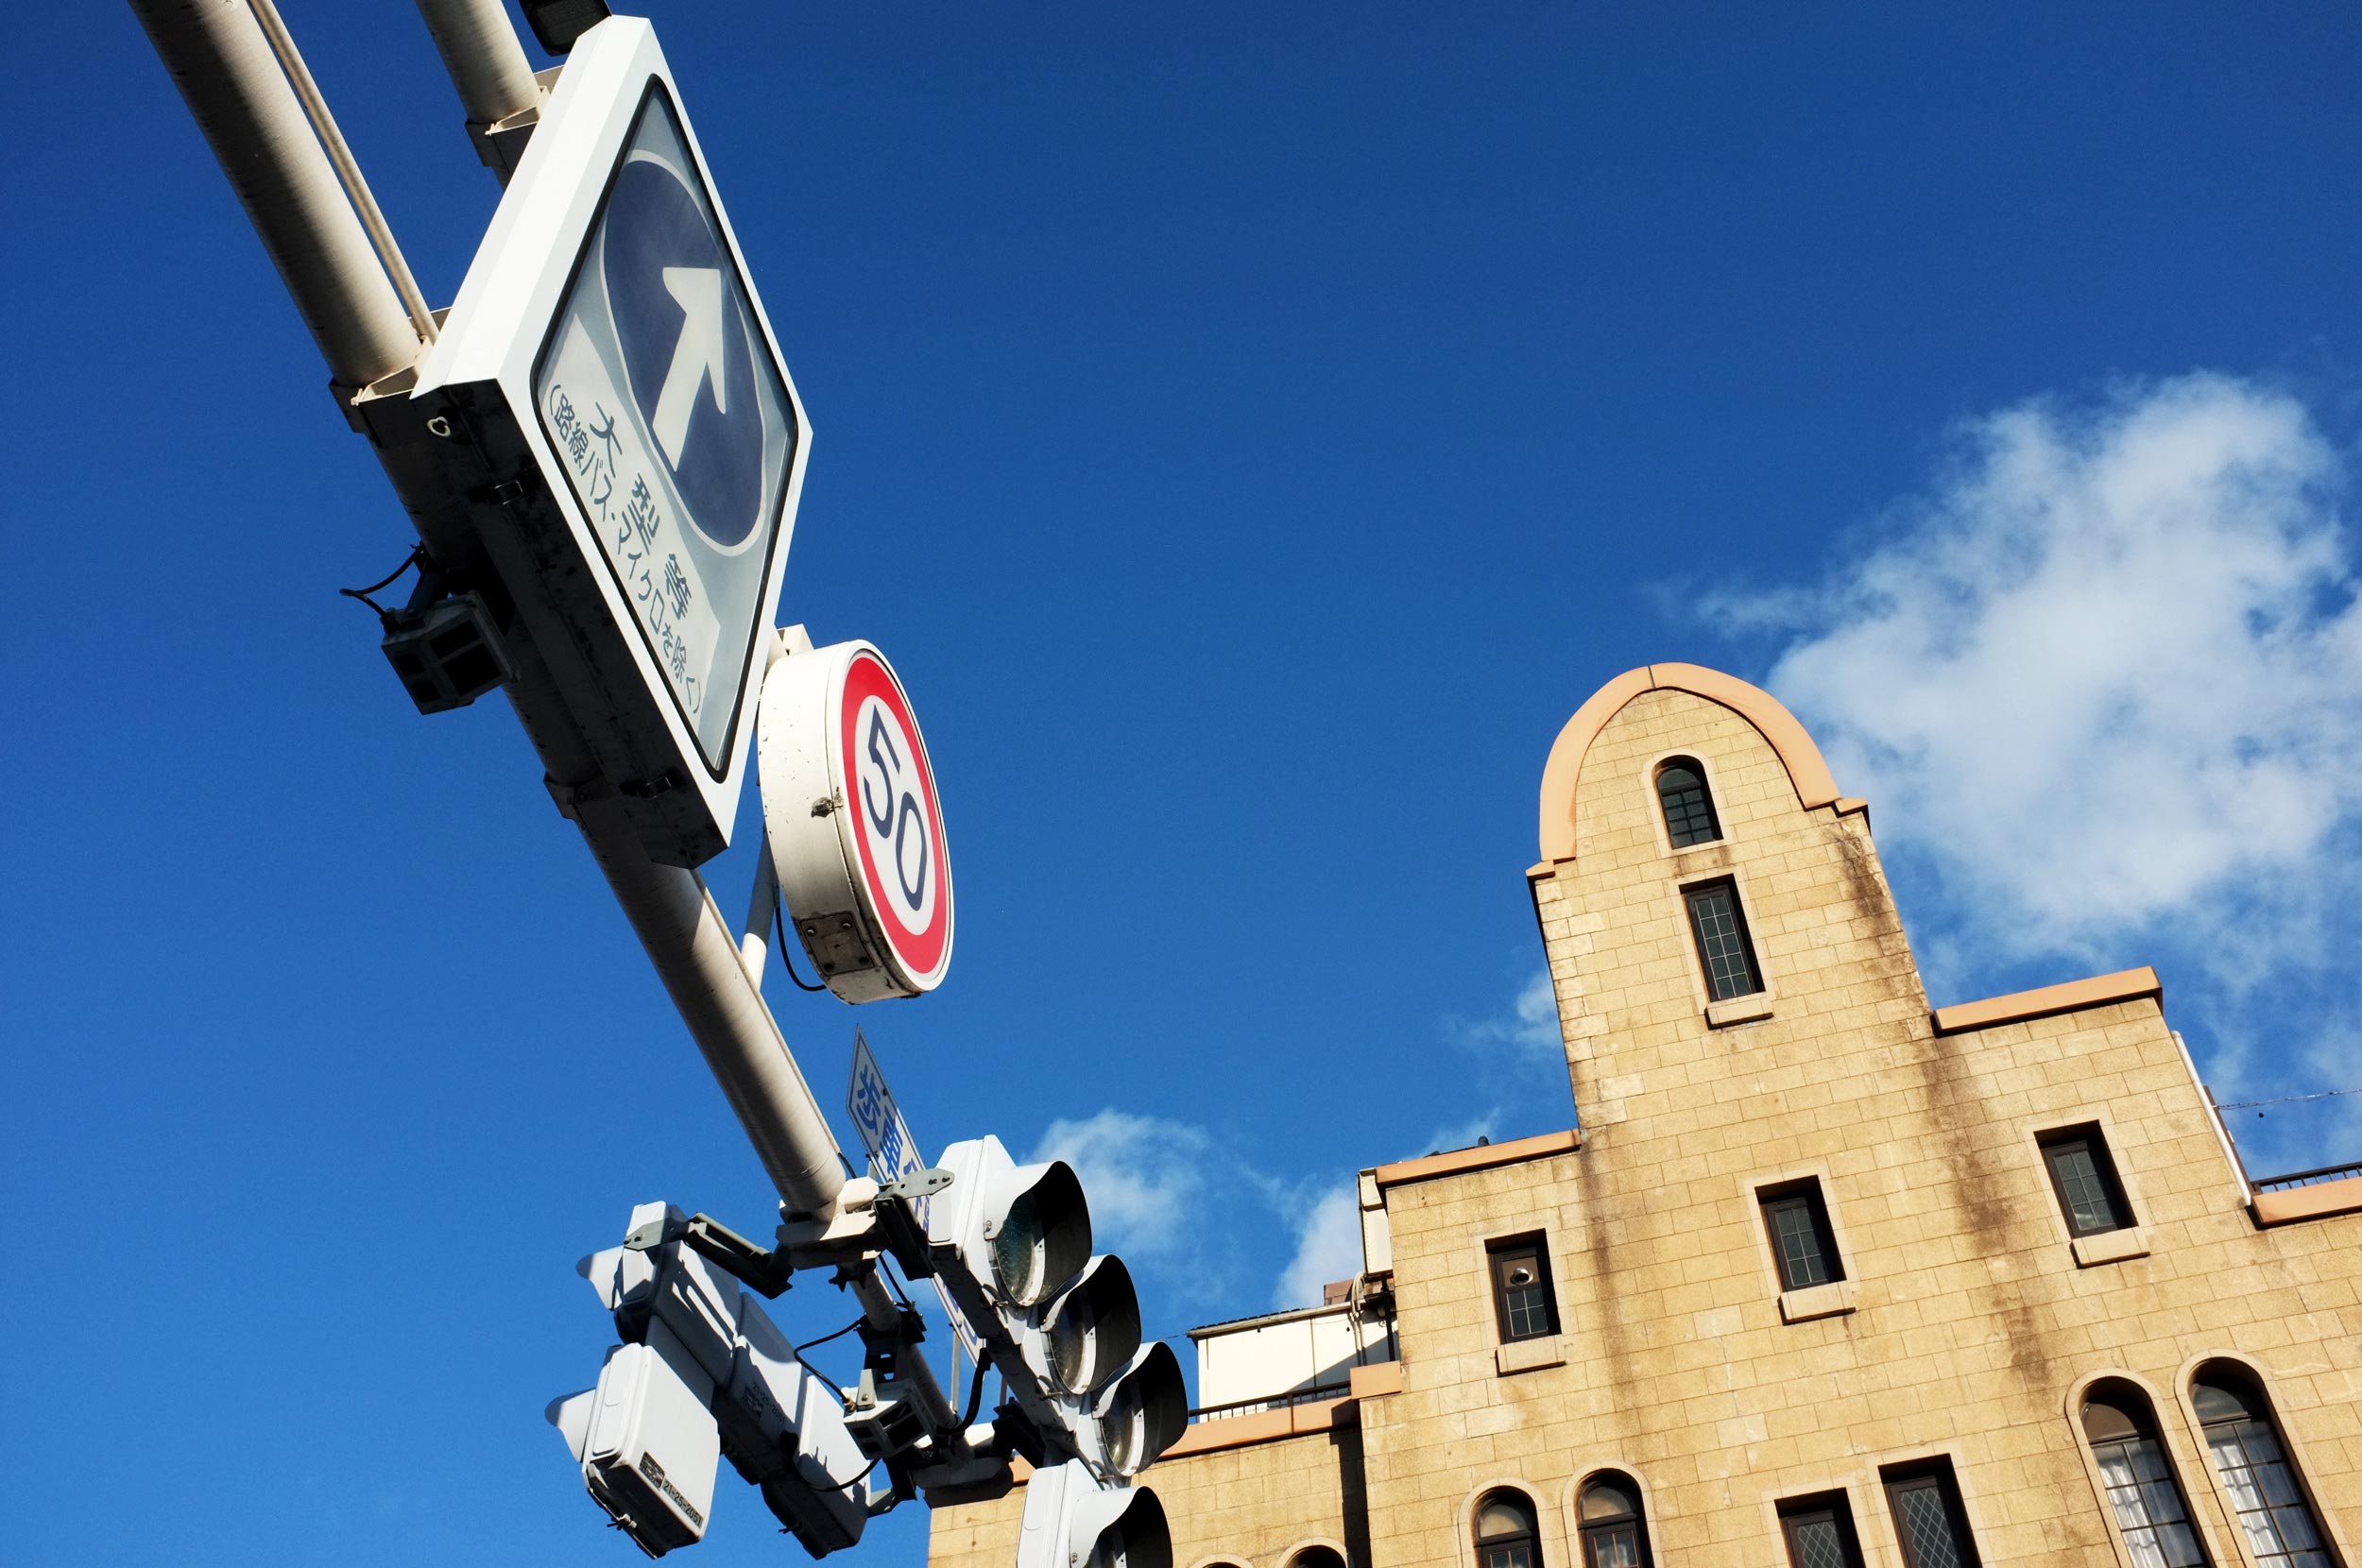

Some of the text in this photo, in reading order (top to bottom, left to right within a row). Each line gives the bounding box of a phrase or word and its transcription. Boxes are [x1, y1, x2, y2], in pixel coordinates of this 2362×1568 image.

[589, 401, 693, 620] 大型等
[864, 704, 927, 912] 50
